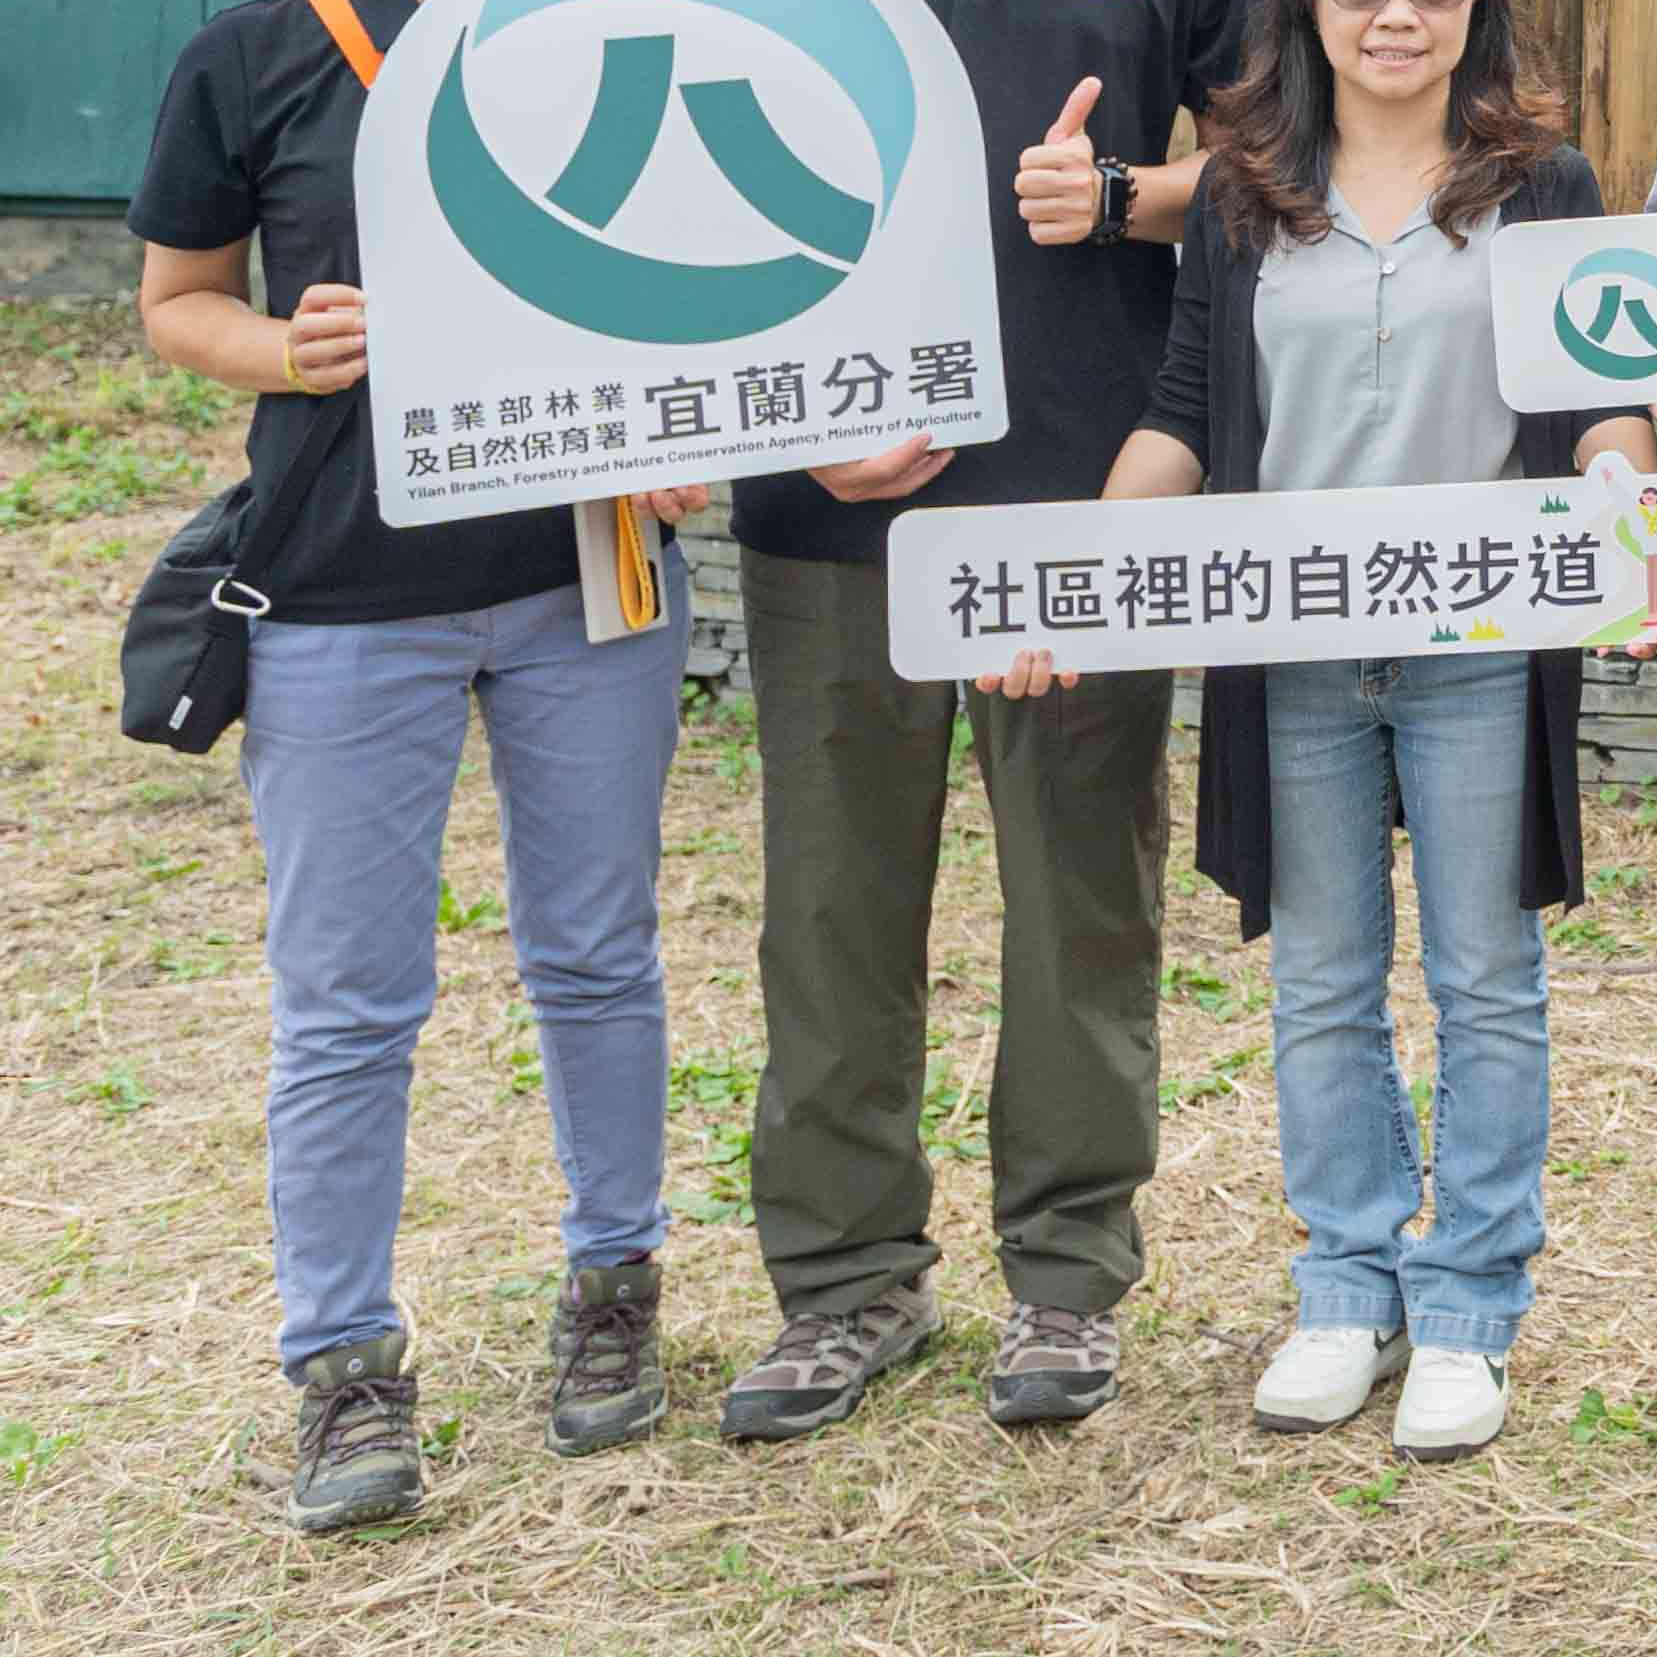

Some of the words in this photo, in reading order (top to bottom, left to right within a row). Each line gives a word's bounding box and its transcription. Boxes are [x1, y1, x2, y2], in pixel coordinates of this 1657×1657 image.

[403, 382, 628, 439] 農業部林業
[644, 340, 978, 442] 宜蘭分署
[406, 421, 628, 477] 及自然保育署
[408, 485, 447, 500] Yilan
[451, 476, 509, 494] Branch,
[514, 466, 577, 485] Forestry
[583, 461, 609, 475] and
[614, 453, 664, 470] Nature
[668, 441, 764, 463] Conservation
[769, 431, 824, 449] Agency,
[828, 421, 883, 440] Ministry
[887, 419, 901, 432] of
[905, 409, 982, 431] Agriculture
[949, 532, 1604, 639] 社區裡的自然步道
